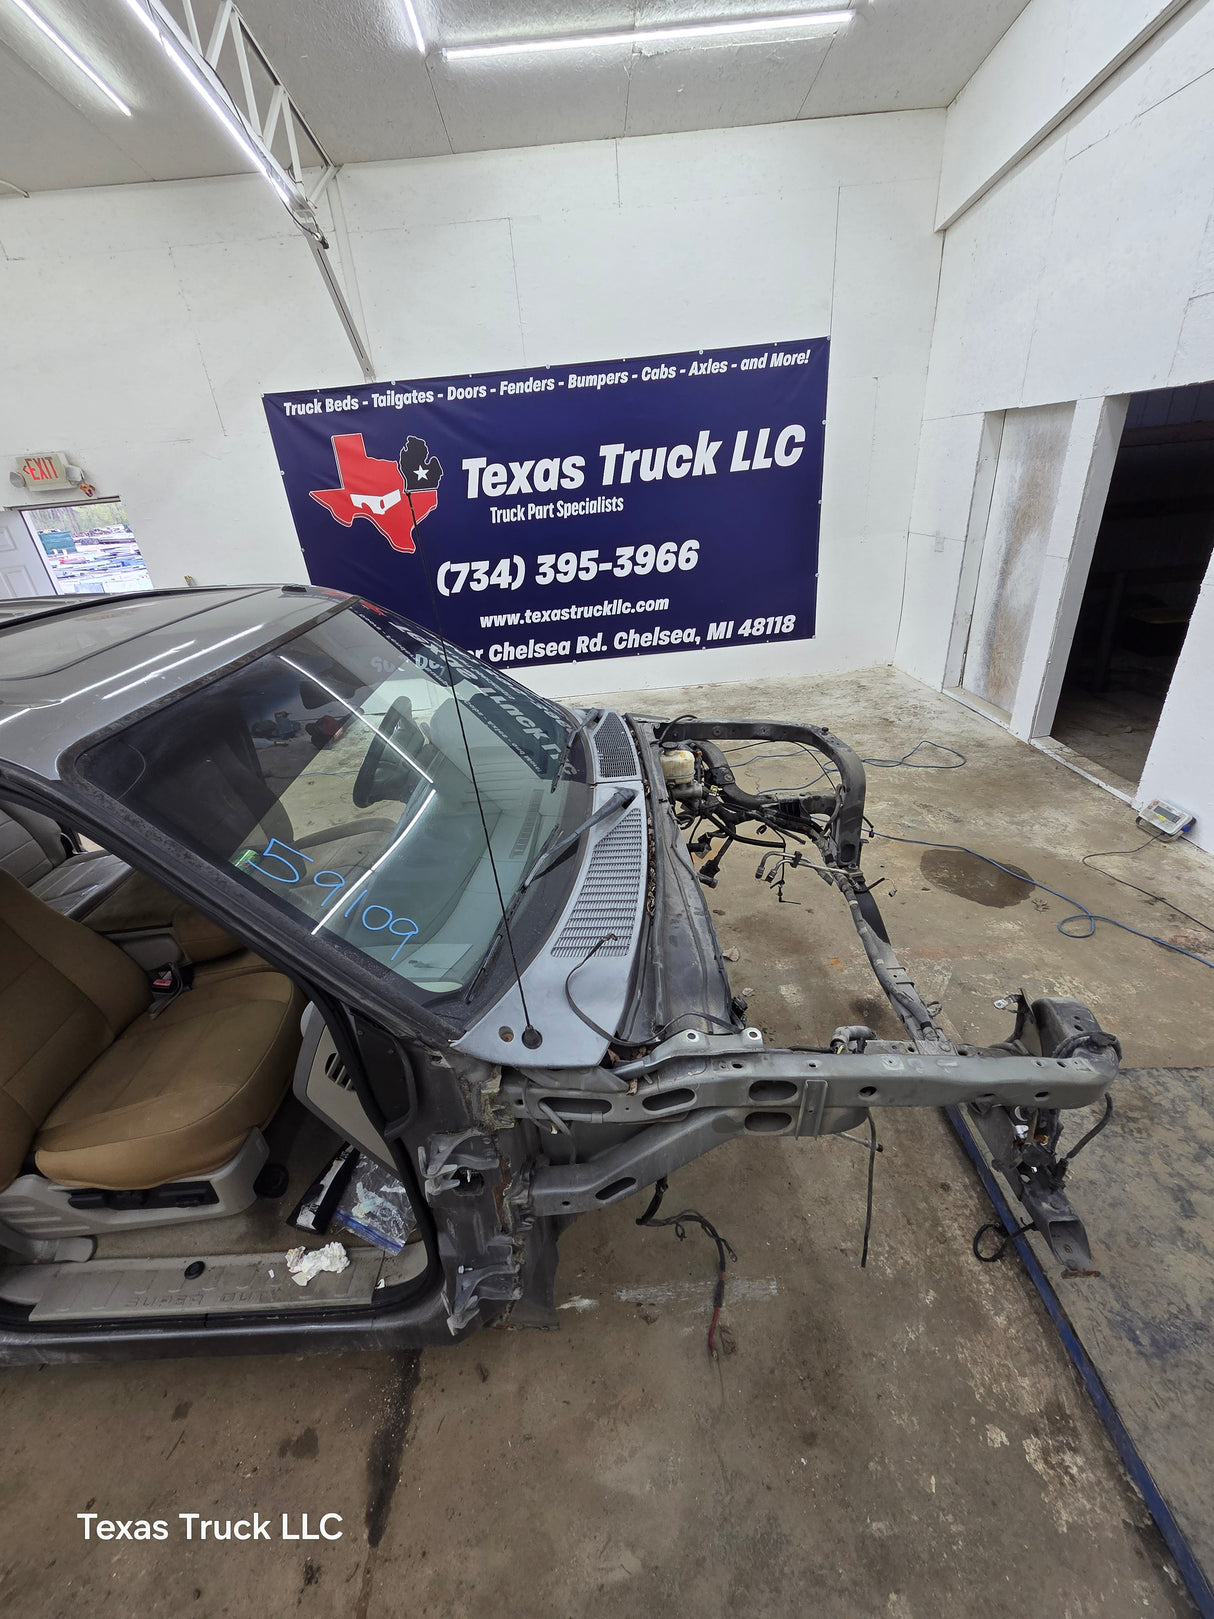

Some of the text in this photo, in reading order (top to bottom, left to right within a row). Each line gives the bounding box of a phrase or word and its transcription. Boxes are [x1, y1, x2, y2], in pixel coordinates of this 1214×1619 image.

[284, 398, 322, 416] Truck
[325, 395, 359, 412] Beds
[371, 389, 434, 409] Tailgates
[447, 383, 487, 401] Doors
[499, 376, 555, 396] Fenders
[568, 369, 629, 390] Bumpers
[641, 364, 676, 381] Cabs
[688, 358, 728, 376] Axles
[740, 354, 768, 371] and
[769, 349, 811, 368] More!
[24, 456, 59, 481] EXIT
[462, 424, 806, 499] Texas Truck LLC
[490, 496, 624, 524] Truck Part Specialists
[436, 539, 700, 597] (734) 395-3966
[480, 598, 669, 628] www.texastruckllc.com
[488, 639, 571, 662] Chelsea
[576, 632, 607, 653] Rd.
[613, 626, 701, 650] Chelsea,
[706, 620, 735, 641] MI
[737, 614, 796, 637] 48118
